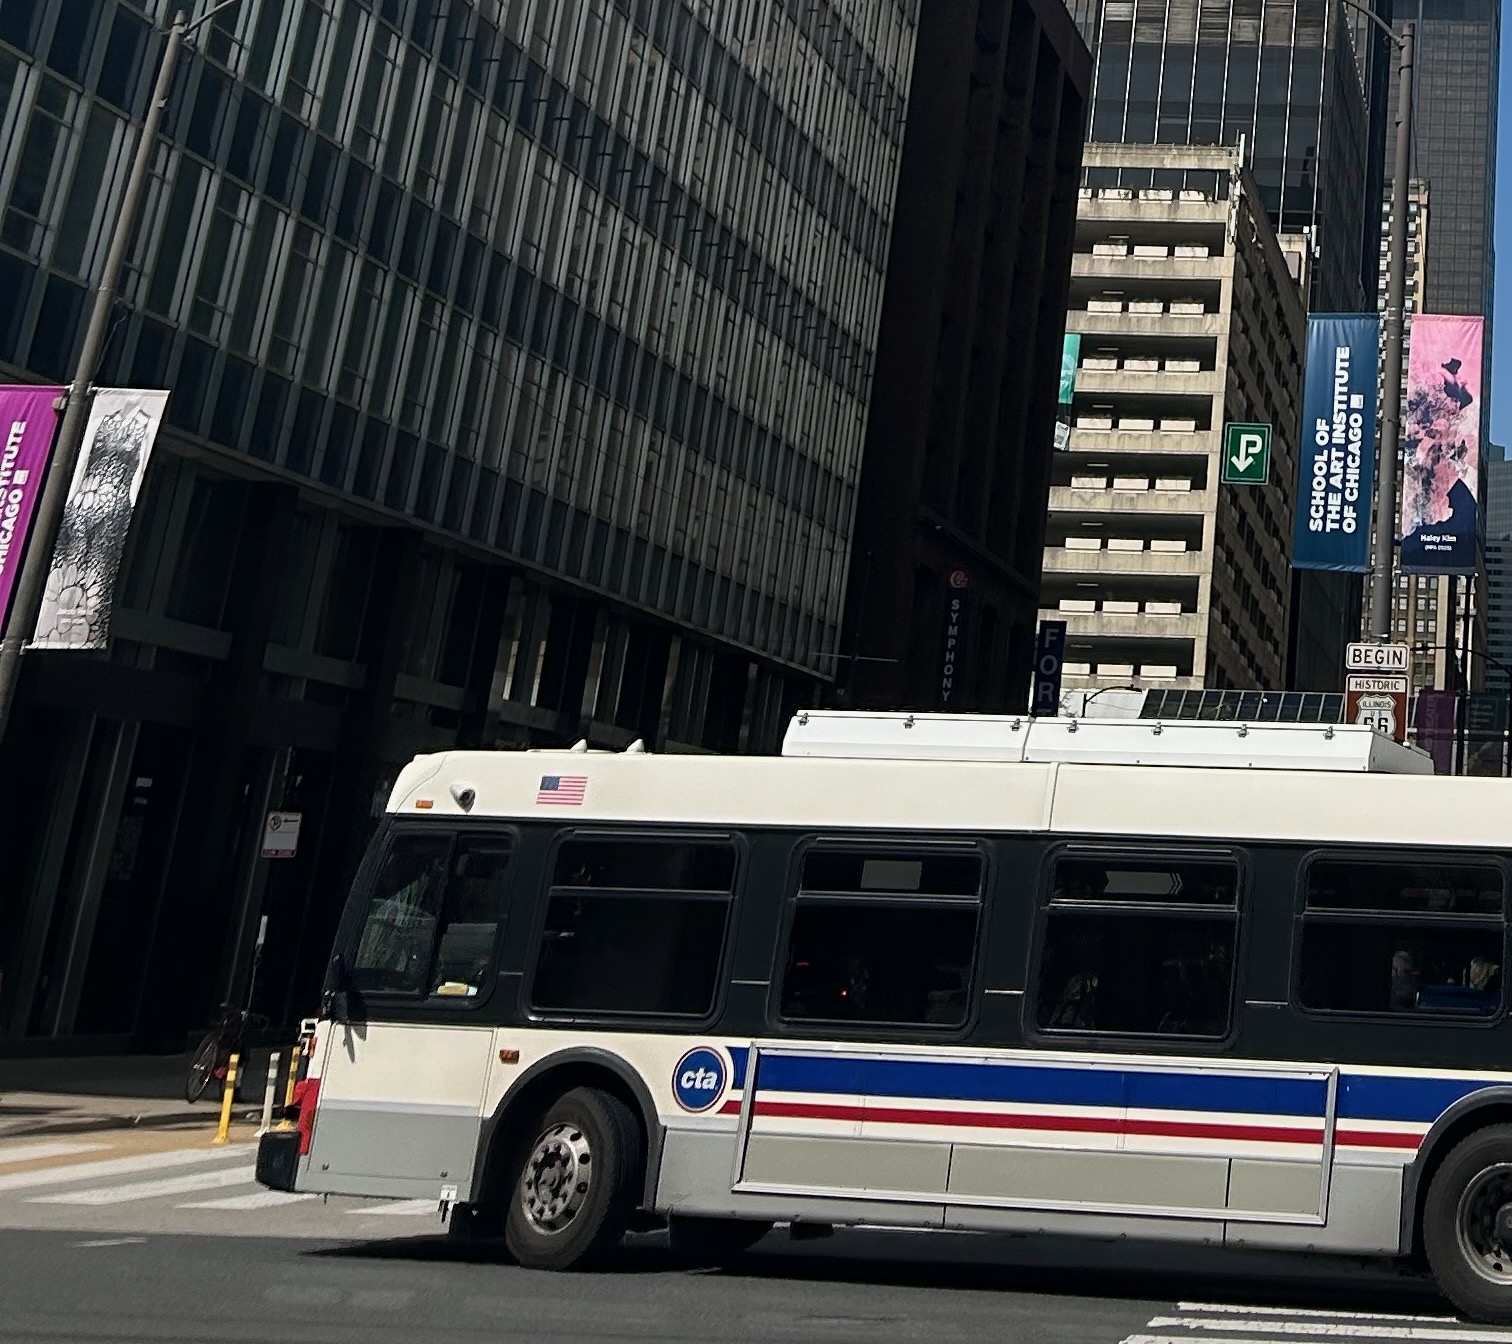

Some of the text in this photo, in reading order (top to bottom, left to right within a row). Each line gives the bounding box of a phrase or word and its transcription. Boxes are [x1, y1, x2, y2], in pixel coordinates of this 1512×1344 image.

[1326, 346, 1350, 532] THE ART INSTITUTE
[1345, 413, 1364, 502] CHICAGO
[1309, 418, 1330, 532] SCHOOL OF
[1342, 504, 1358, 534] OF
[942, 599, 961, 701] SYMPHONY
[1036, 628, 1060, 716] FOR
[1352, 648, 1403, 665] BEGIN
[1355, 679, 1400, 690] HISTORIC
[1363, 700, 1392, 709] ILLINOIS
[681, 1067, 717, 1089] cta
